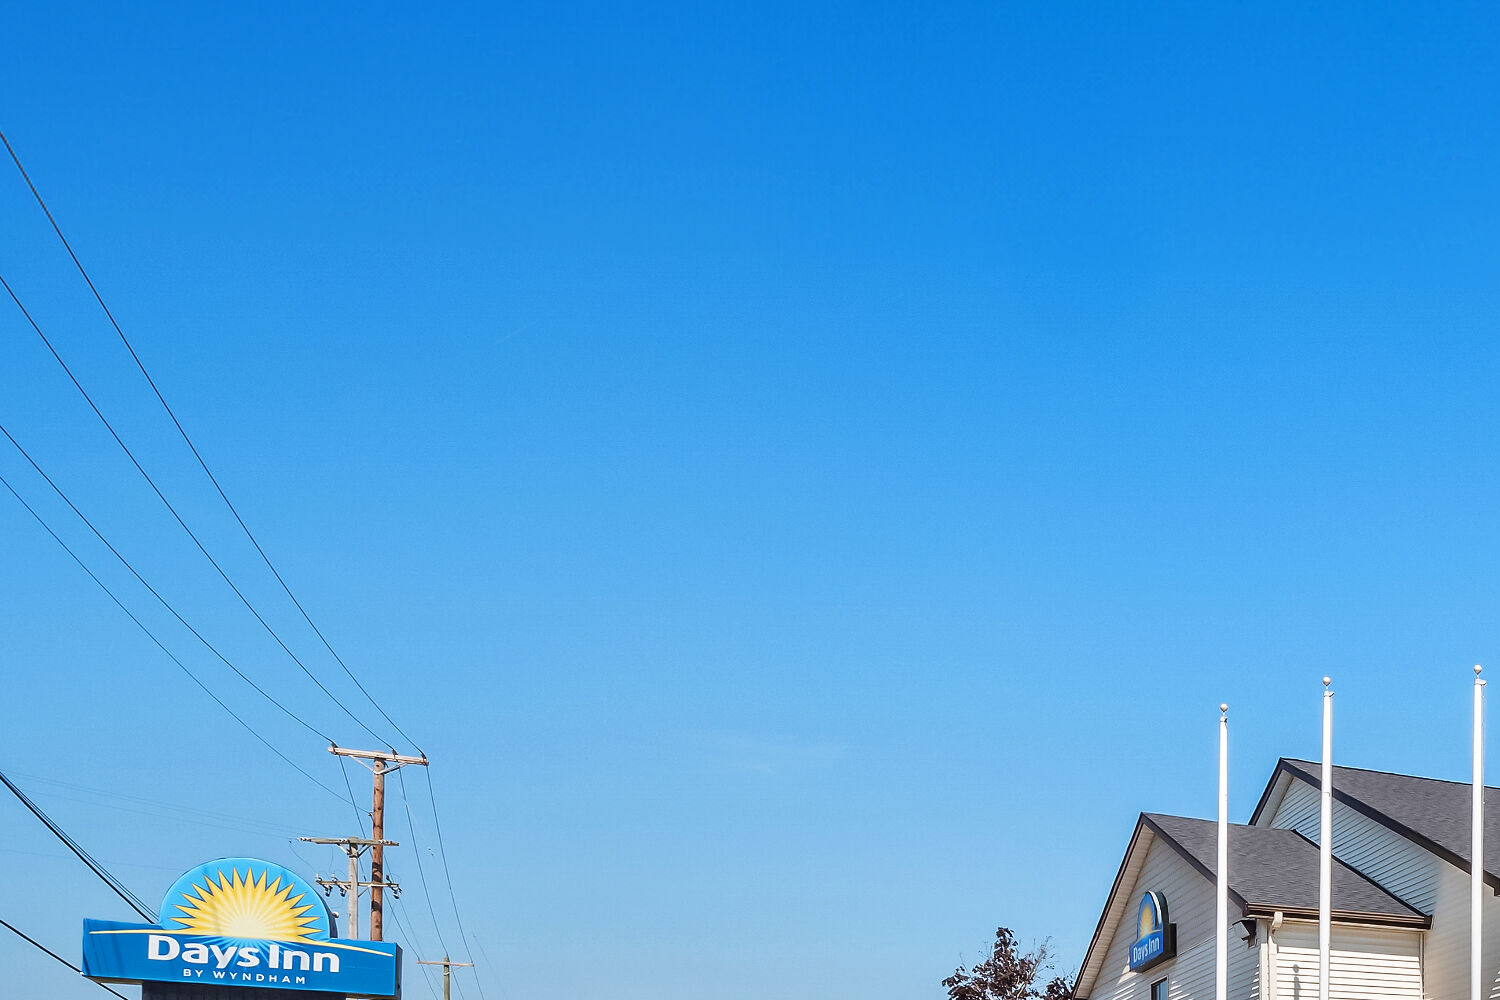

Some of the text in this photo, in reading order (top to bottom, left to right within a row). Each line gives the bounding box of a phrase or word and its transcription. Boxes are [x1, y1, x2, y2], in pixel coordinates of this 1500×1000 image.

[148, 934, 340, 973] Days Inn
[1133, 937, 1160, 963] Days Inn
[183, 968, 306, 985] BY WYNDHAM
